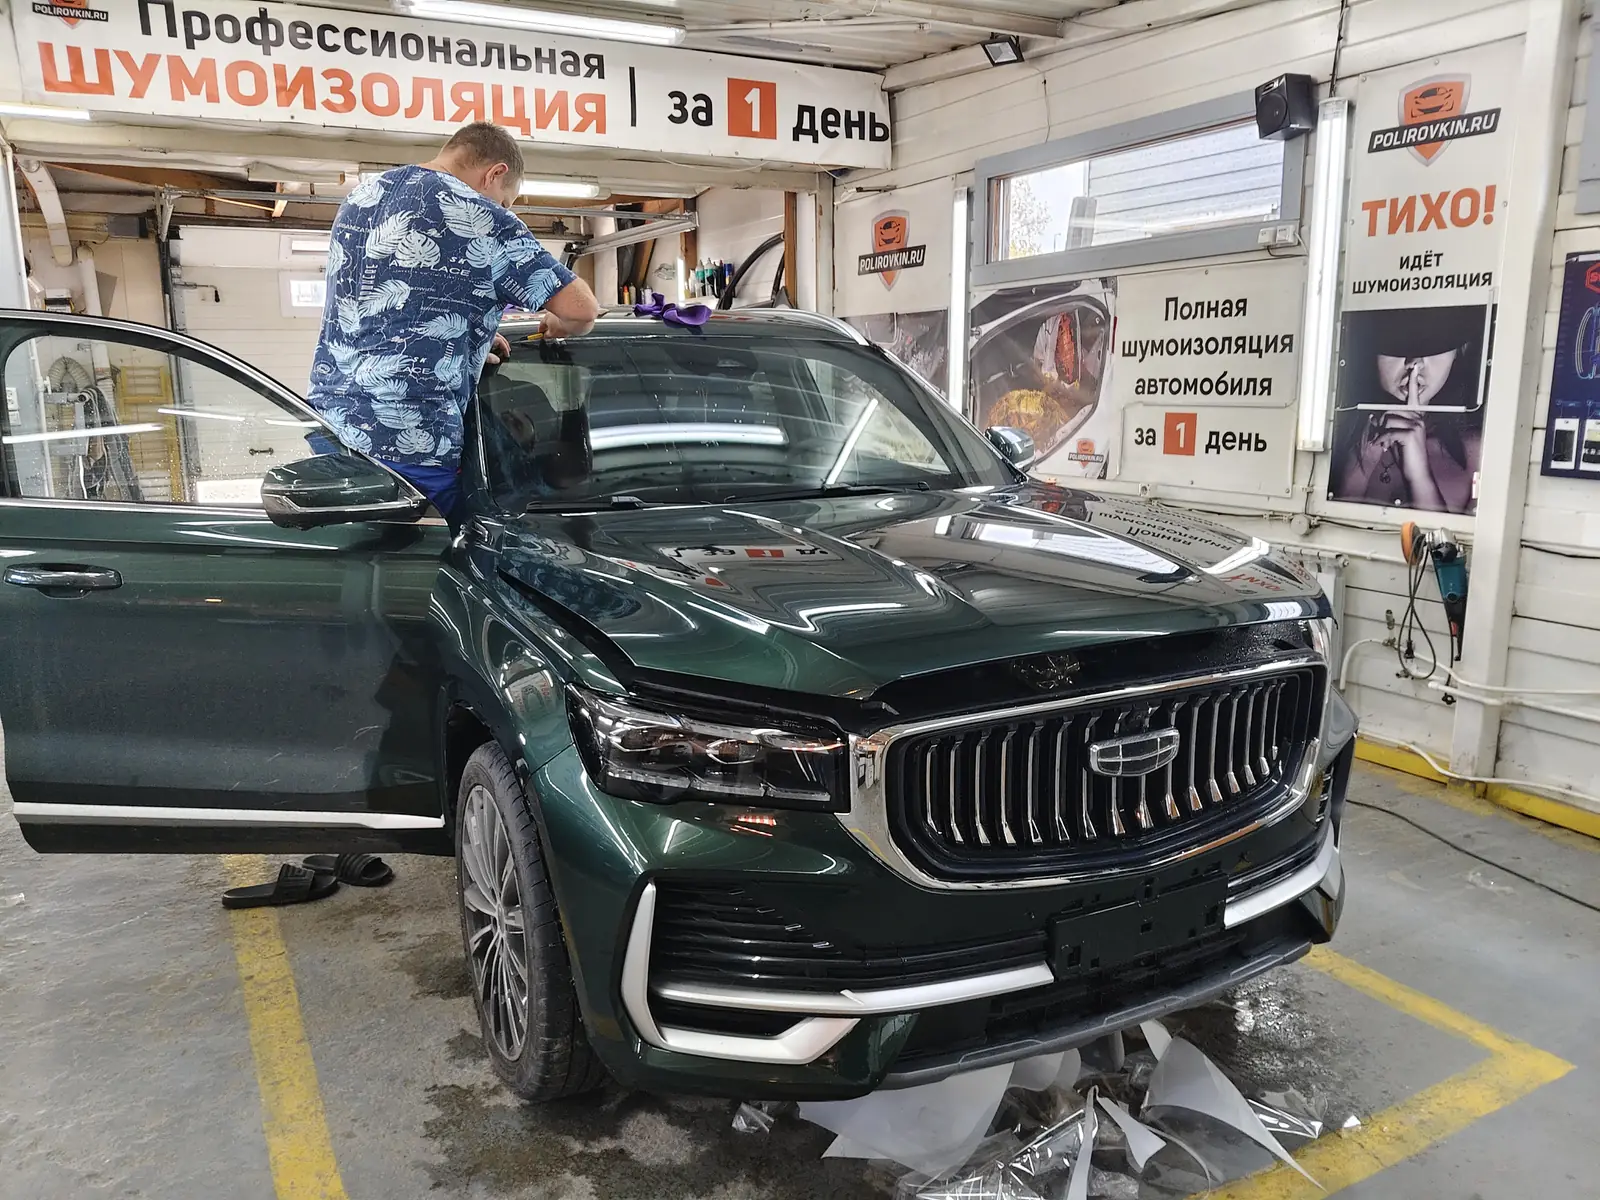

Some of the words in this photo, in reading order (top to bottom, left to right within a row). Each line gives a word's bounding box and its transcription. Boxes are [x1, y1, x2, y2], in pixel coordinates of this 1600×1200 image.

[34, 4, 107, 20] POLIROVKIN.RU
[138, 0, 605, 80] Профессиональная
[37, 41, 607, 136] ШУМОИЗОЛЯЦИЯ
[667, 90, 713, 127] за
[792, 103, 890, 143] день
[1372, 112, 1497, 150] POLIROVKIN.RU
[1361, 184, 1497, 237] ТИХО!
[859, 248, 924, 272] POLIROVKIN.RU
[1399, 250, 1443, 271] ИДЁТ
[1352, 271, 1493, 295] ШУМОИЗОЛЯЦИЯ
[1164, 297, 1248, 322] Полная
[1121, 333, 1295, 363] шумоизоляция
[1134, 371, 1273, 397] автомобиля
[1134, 427, 1157, 446] за
[1204, 430, 1268, 455] день
